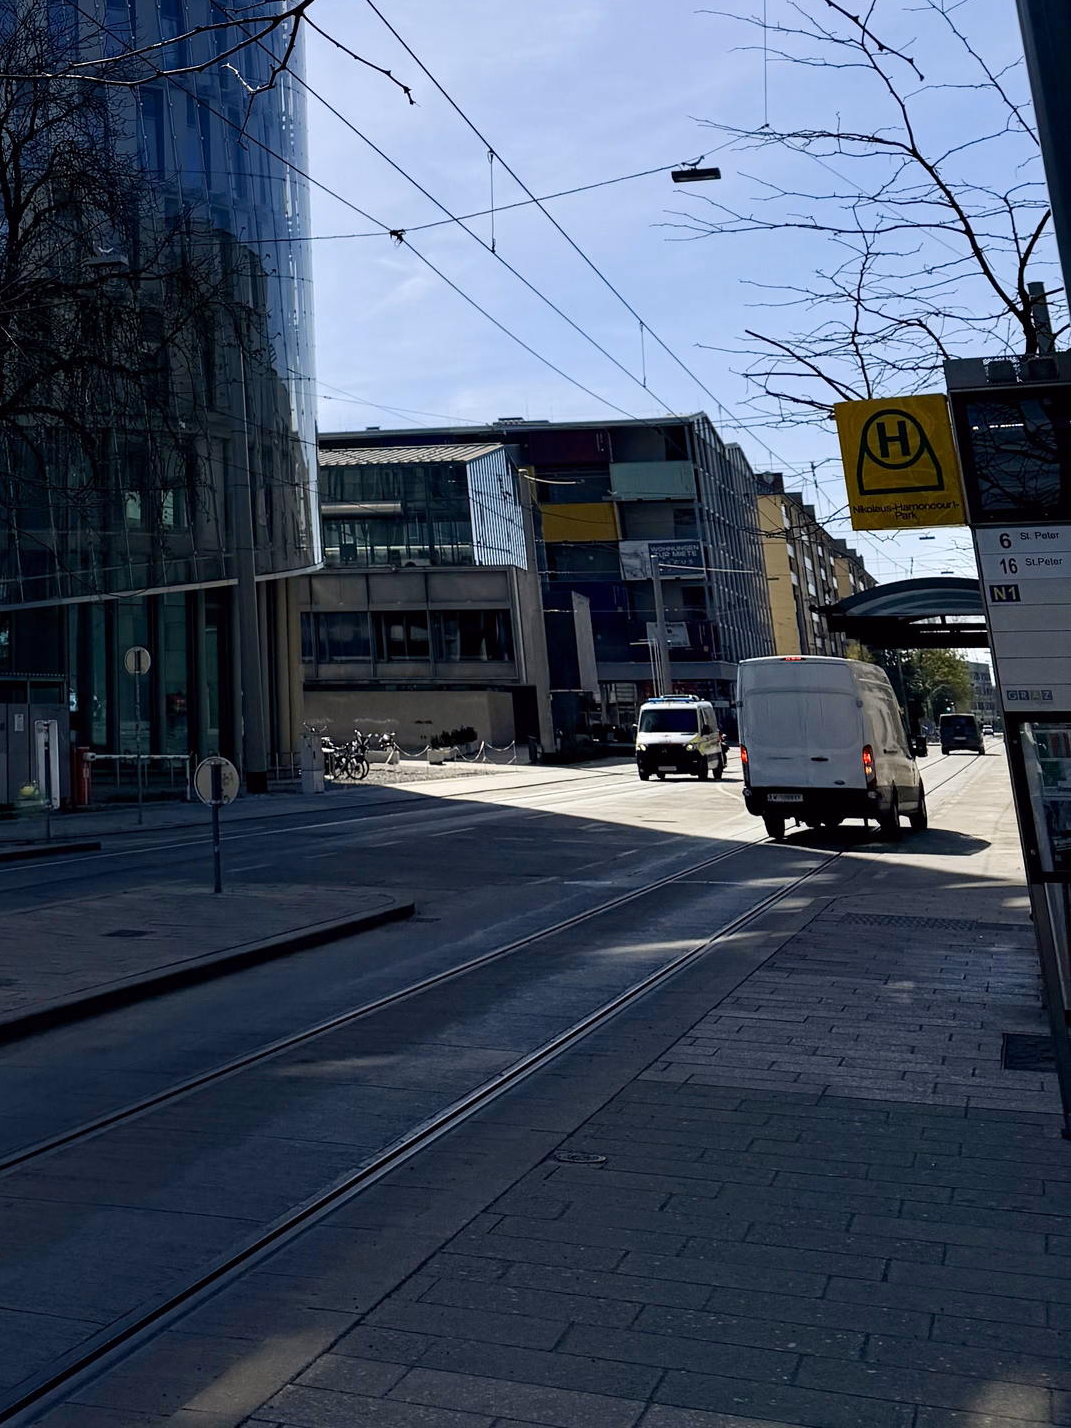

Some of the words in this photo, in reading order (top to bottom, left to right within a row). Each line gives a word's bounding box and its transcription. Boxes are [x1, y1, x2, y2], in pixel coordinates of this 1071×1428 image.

[876, 420, 911, 458] H
[852, 500, 960, 514] Nikolaus-Harnoncourt-
[895, 511, 918, 520] Park
[999, 533, 1012, 549] 6
[1020, 532, 1032, 540] St.
[1034, 531, 1060, 540] Peter
[650, 545, 699, 553] WOHNUNGEN
[1000, 558, 1018, 575] 16
[993, 585, 1017, 601] N1
[1007, 689, 1053, 700] GRAZ
